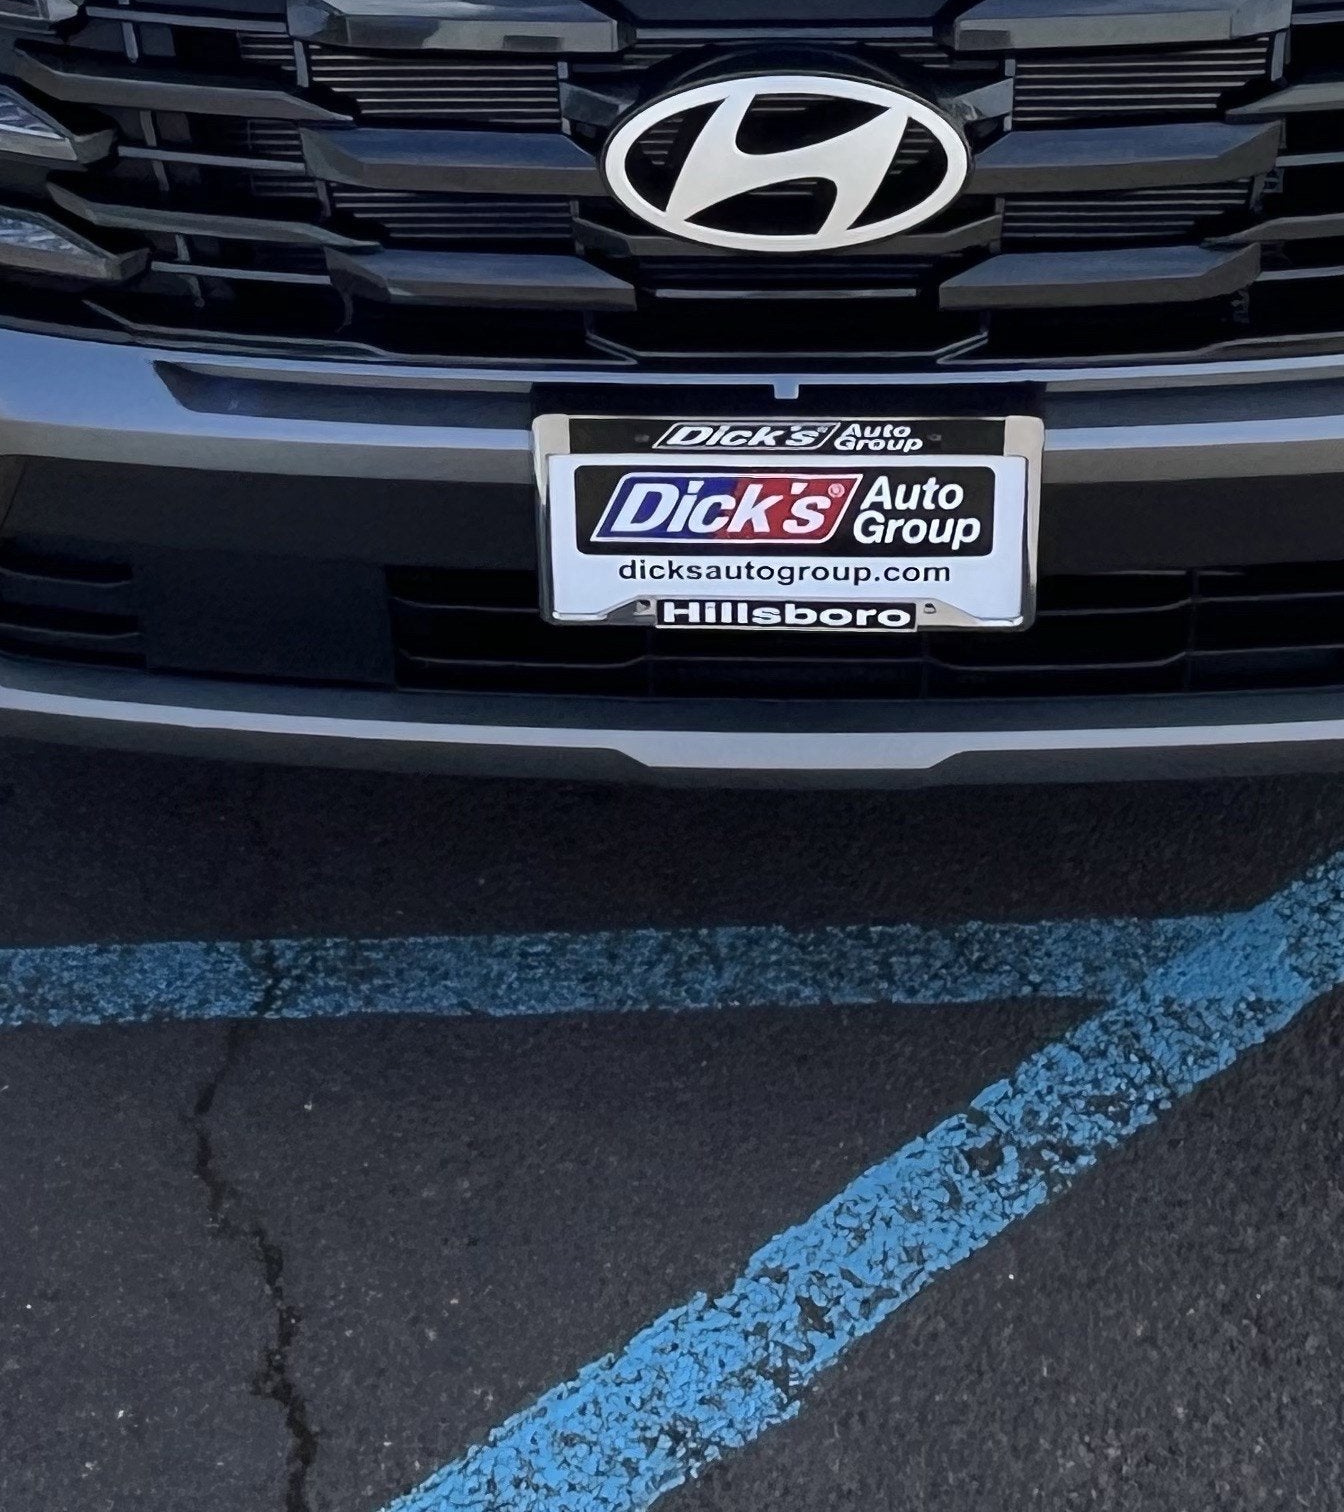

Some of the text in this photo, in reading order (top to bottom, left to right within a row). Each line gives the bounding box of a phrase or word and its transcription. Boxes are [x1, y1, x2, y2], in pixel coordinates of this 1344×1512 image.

[666, 424, 820, 446] Dick's
[841, 423, 912, 438] Auto
[833, 437, 924, 453] Group
[859, 474, 965, 511] Auto
[610, 480, 832, 535] Dick's
[852, 510, 982, 551] Group
[618, 559, 952, 586] dicksautogroup.com
[662, 601, 912, 629] Hillsboro
